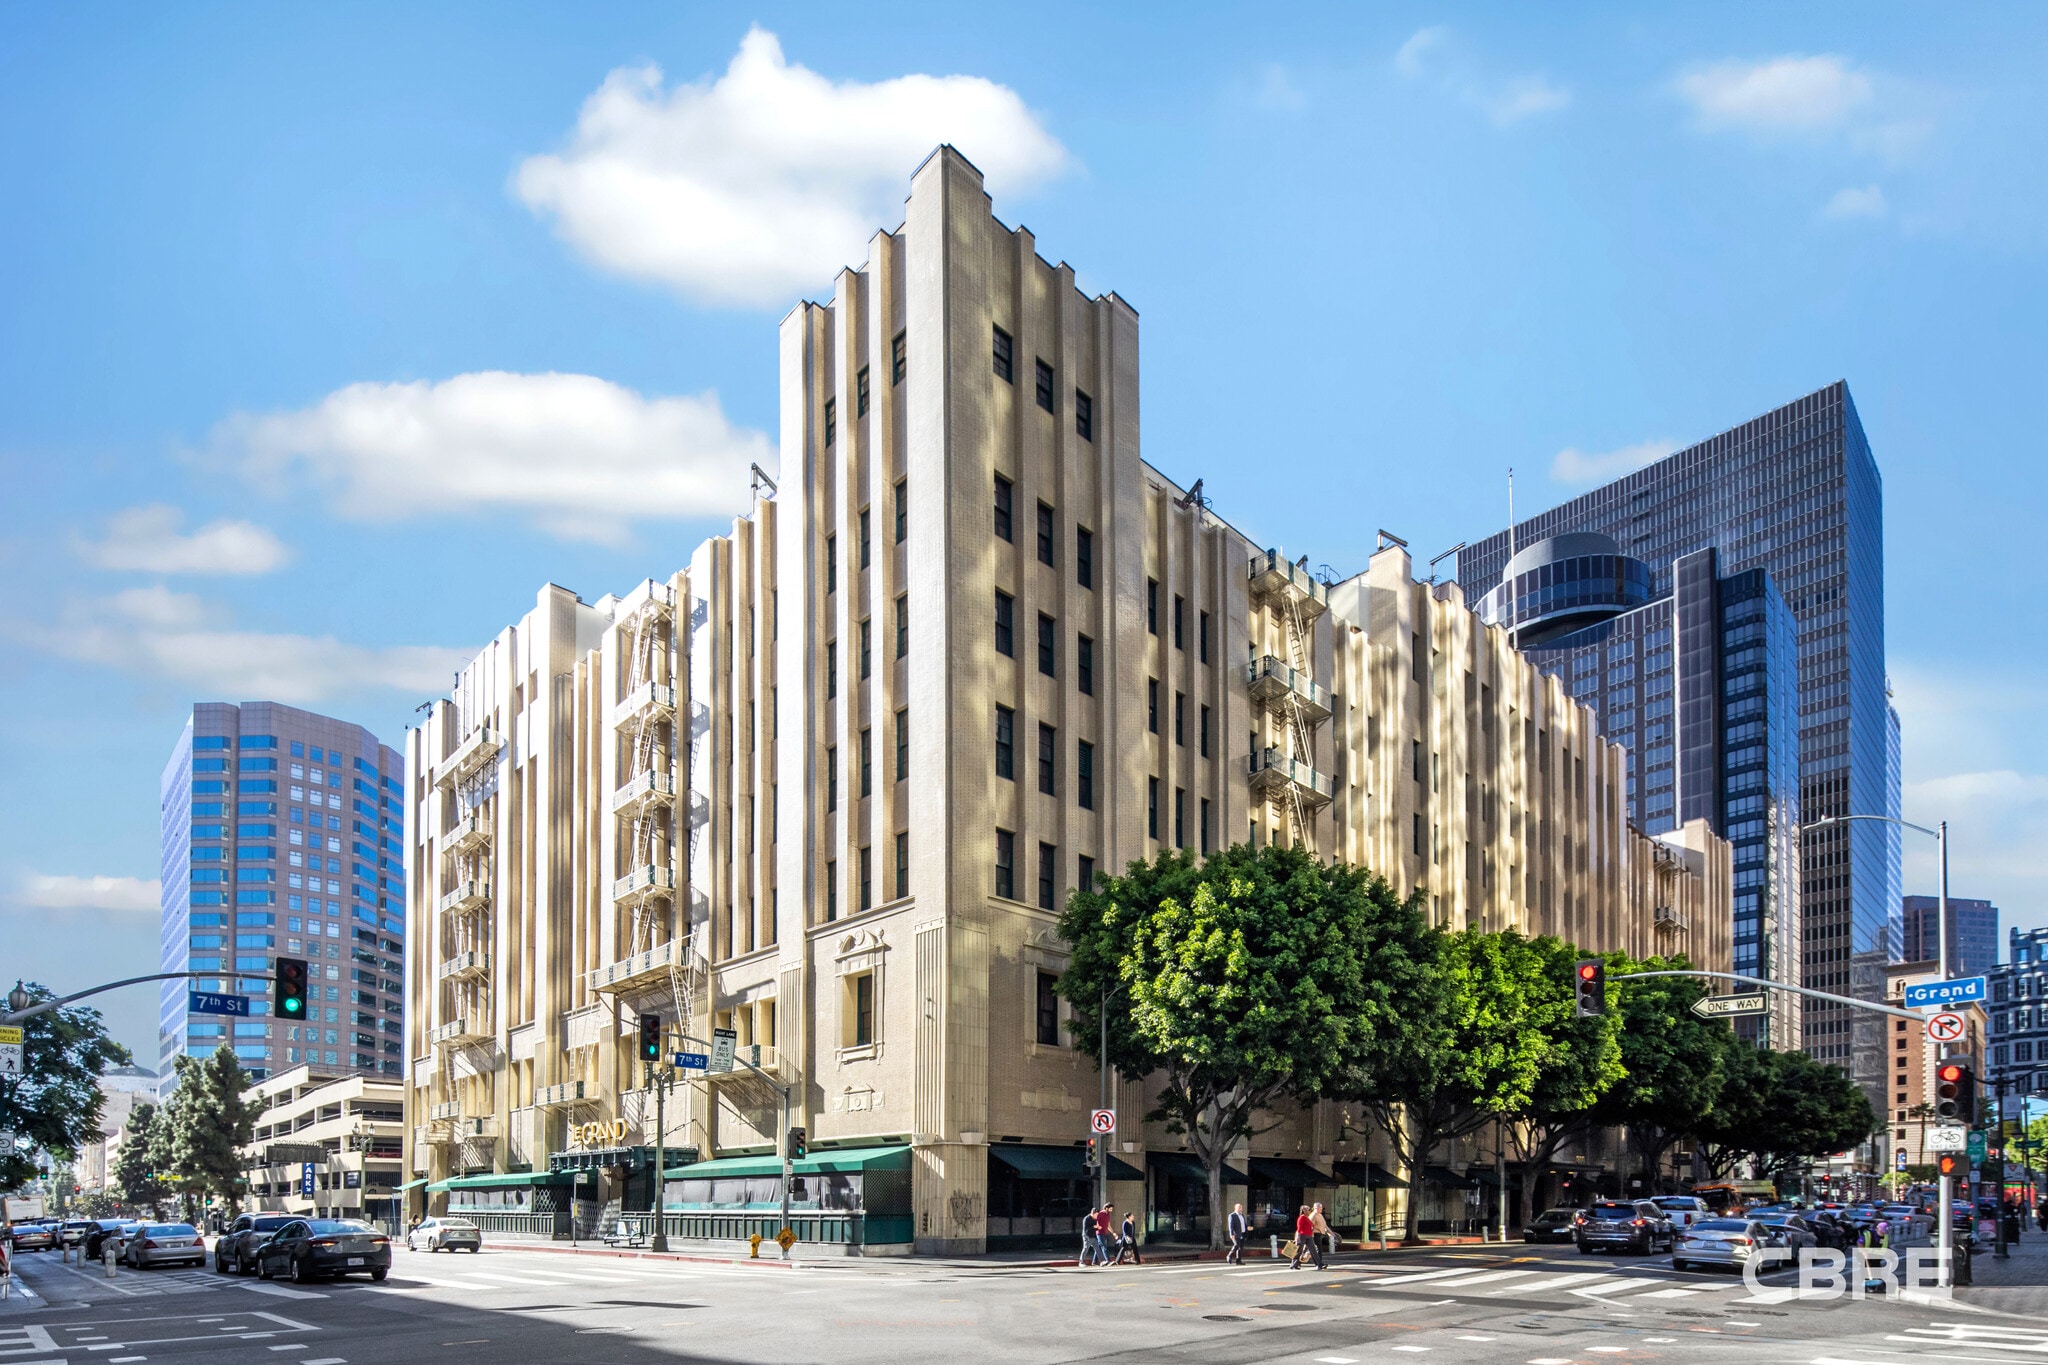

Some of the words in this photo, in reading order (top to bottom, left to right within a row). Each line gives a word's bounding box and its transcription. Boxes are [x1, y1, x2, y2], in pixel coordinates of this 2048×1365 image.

[1914, 982, 1976, 1000] Grand
[196, 995, 221, 1009] 7th
[226, 999, 242, 1011] St
[1707, 1001, 1729, 1012] ONE
[1736, 998, 1760, 1009] WAY
[679, 1055, 693, 1065] 7th
[694, 1057, 704, 1066] St
[582, 1118, 629, 1145] GRAND
[305, 1162, 313, 1187] PARK
